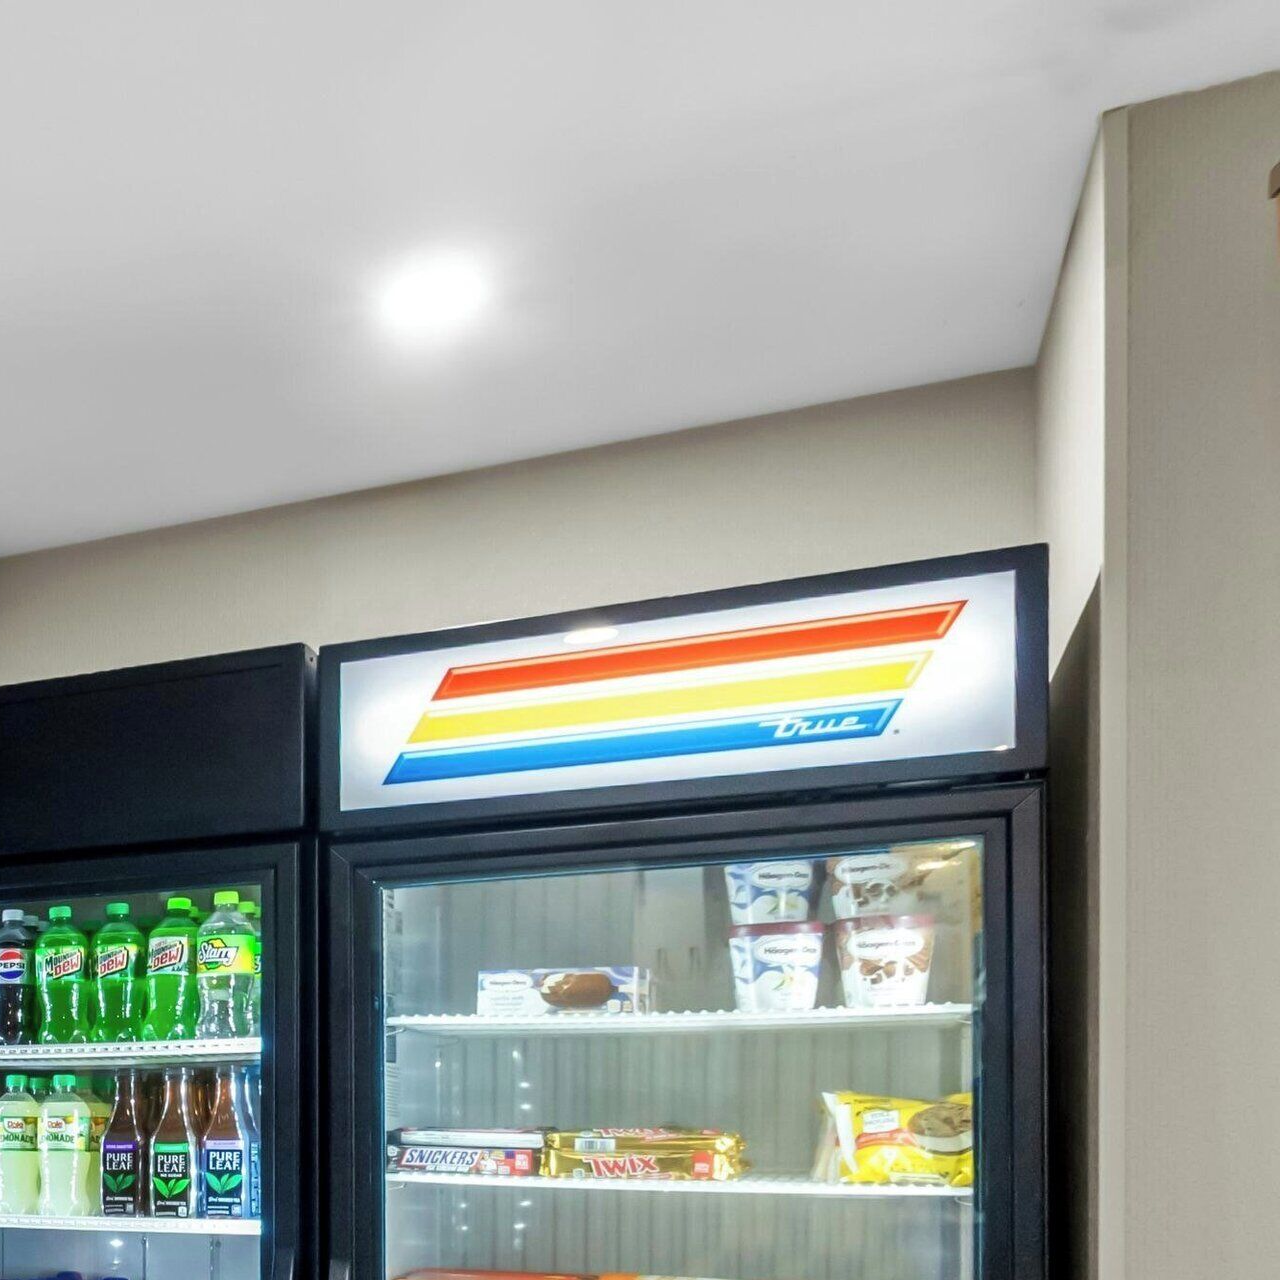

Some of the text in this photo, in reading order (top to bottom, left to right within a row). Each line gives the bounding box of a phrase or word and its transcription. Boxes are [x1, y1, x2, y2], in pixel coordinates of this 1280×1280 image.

[99, 955, 125, 975] DEW
[153, 949, 180, 968] DEW
[54, 959, 80, 977] DEW
[106, 1153, 133, 1162] PURE
[157, 1155, 186, 1164] PURE
[209, 1151, 240, 1161] PURE
[406, 1149, 478, 1166] SNICKERS
[583, 1154, 659, 1178] TWIX
